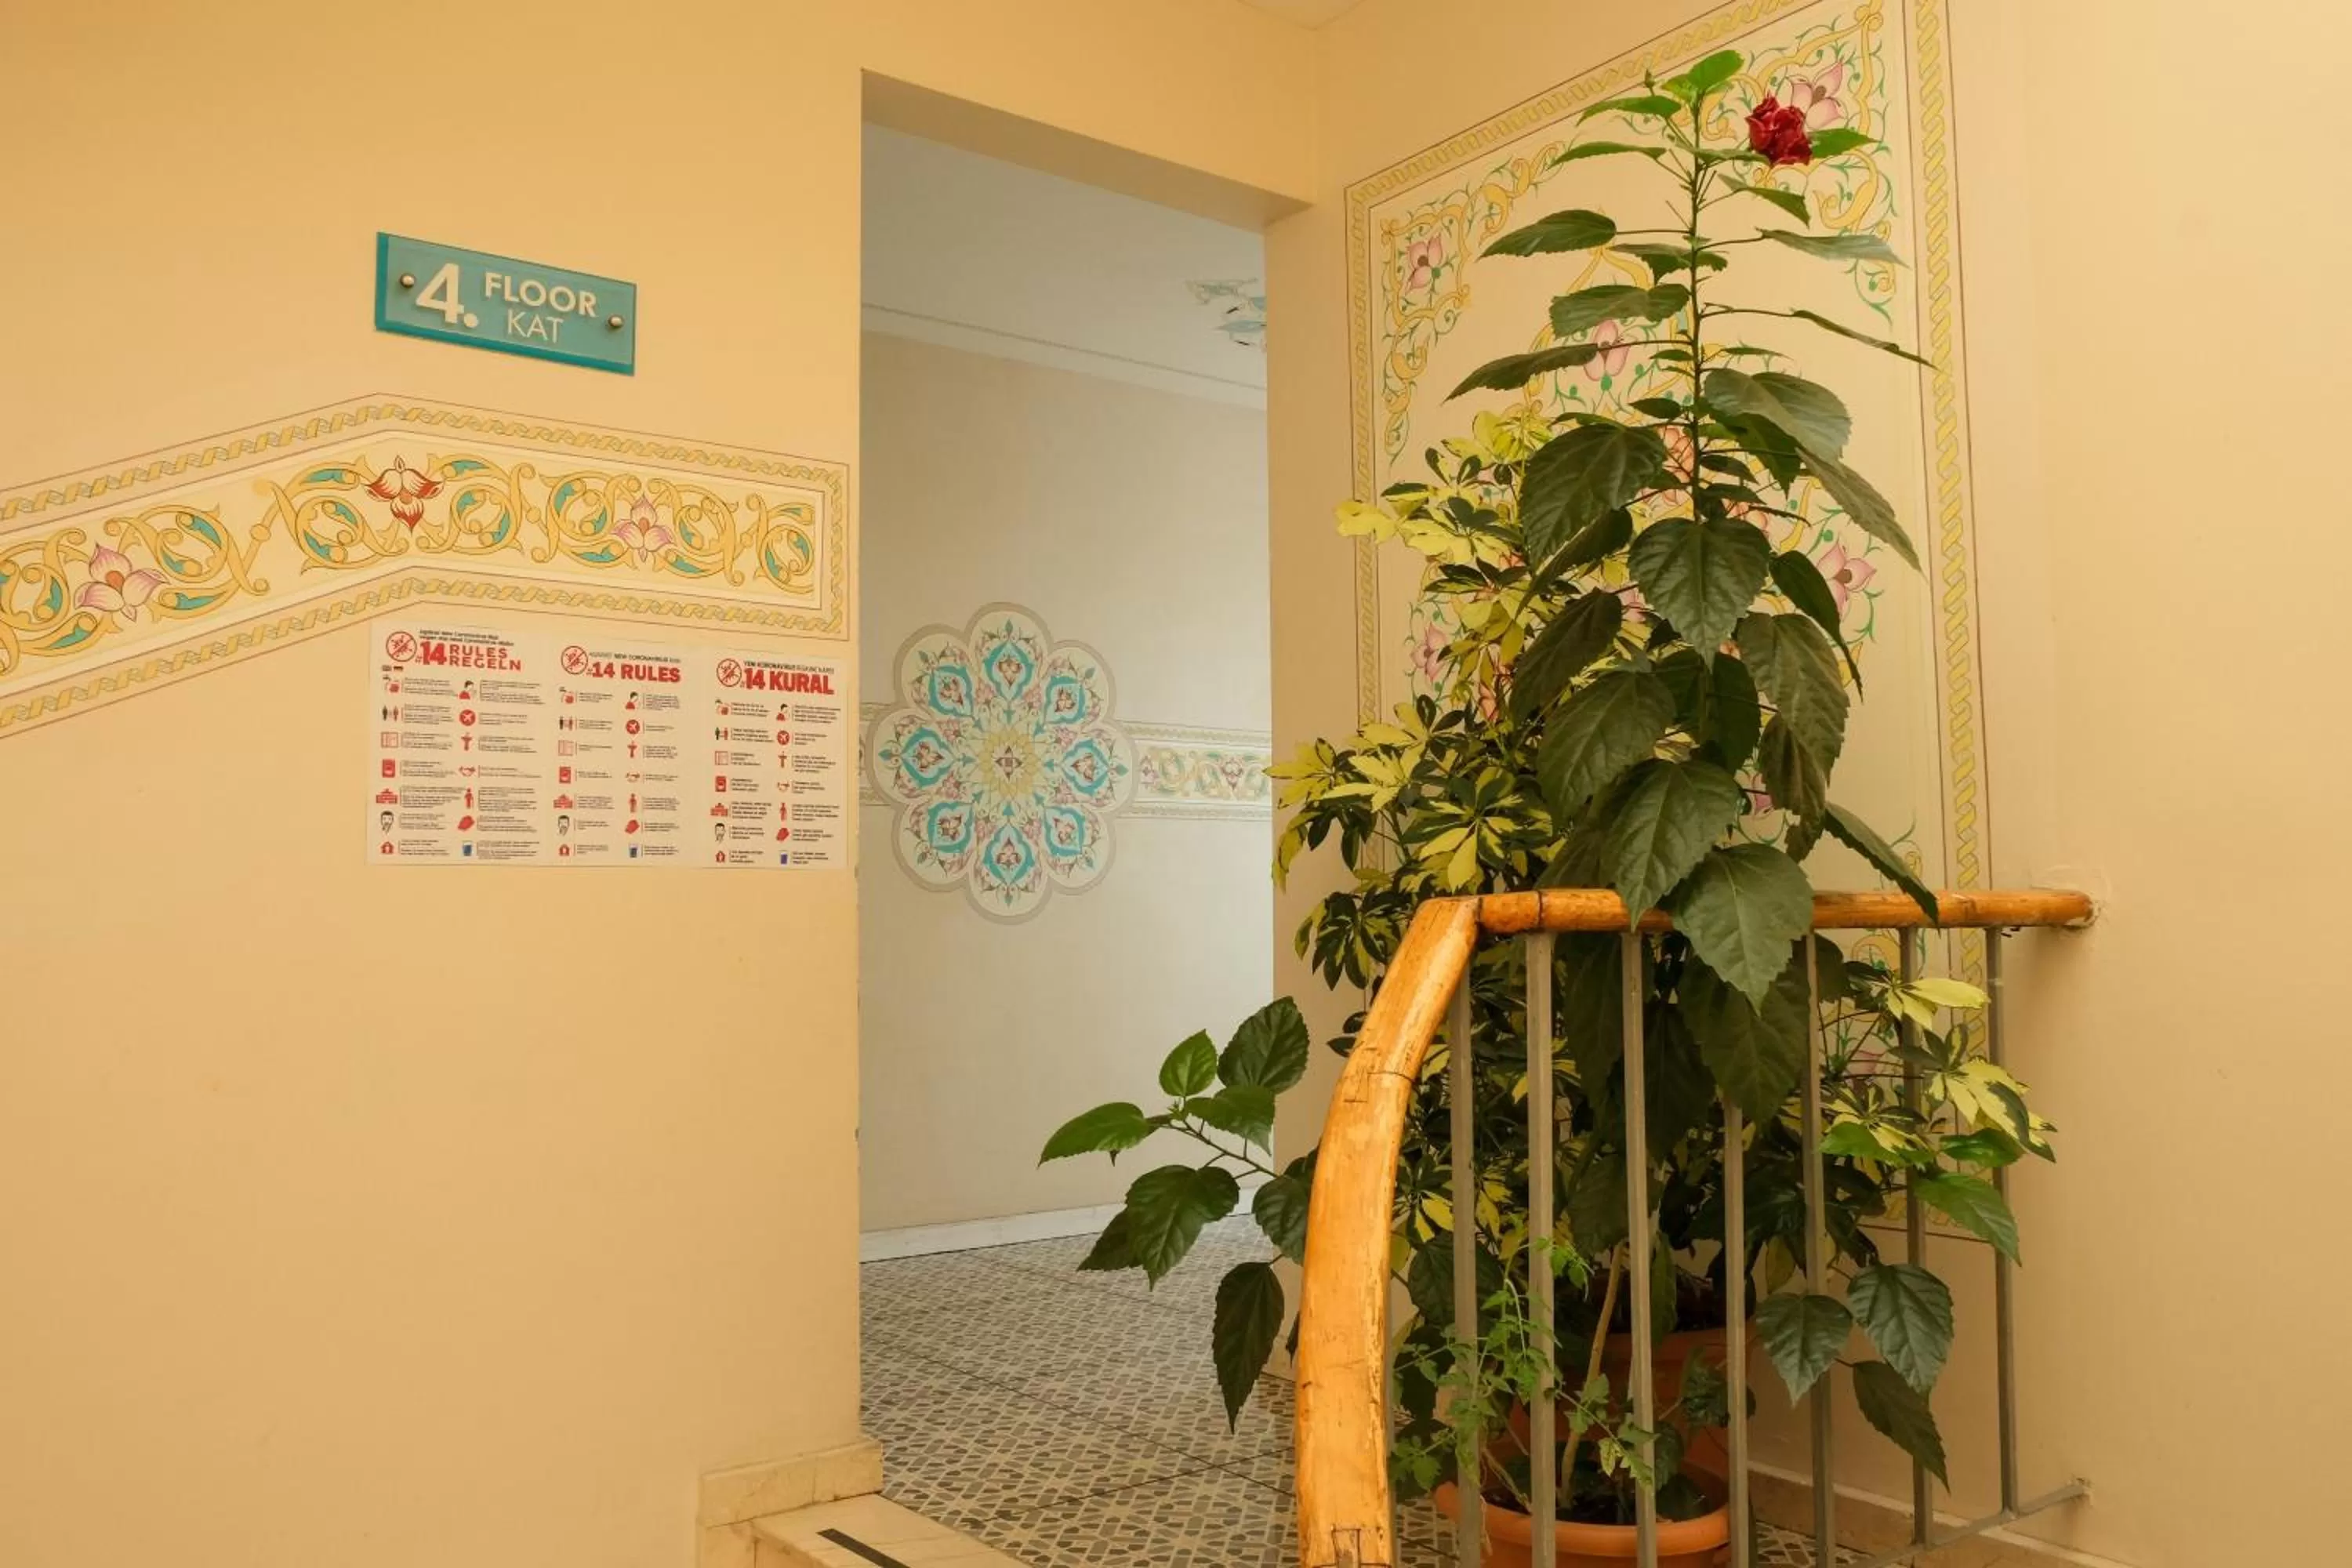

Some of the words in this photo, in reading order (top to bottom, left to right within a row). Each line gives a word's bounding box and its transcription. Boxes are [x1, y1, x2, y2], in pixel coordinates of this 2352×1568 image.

[416, 263, 479, 328] 4.
[485, 272, 599, 318] FLOOR
[506, 309, 564, 343] KAT
[449, 644, 508, 659] RULES
[449, 655, 521, 671] REGELN
[620, 663, 681, 683] RULES
[769, 670, 835, 695] KURAL
